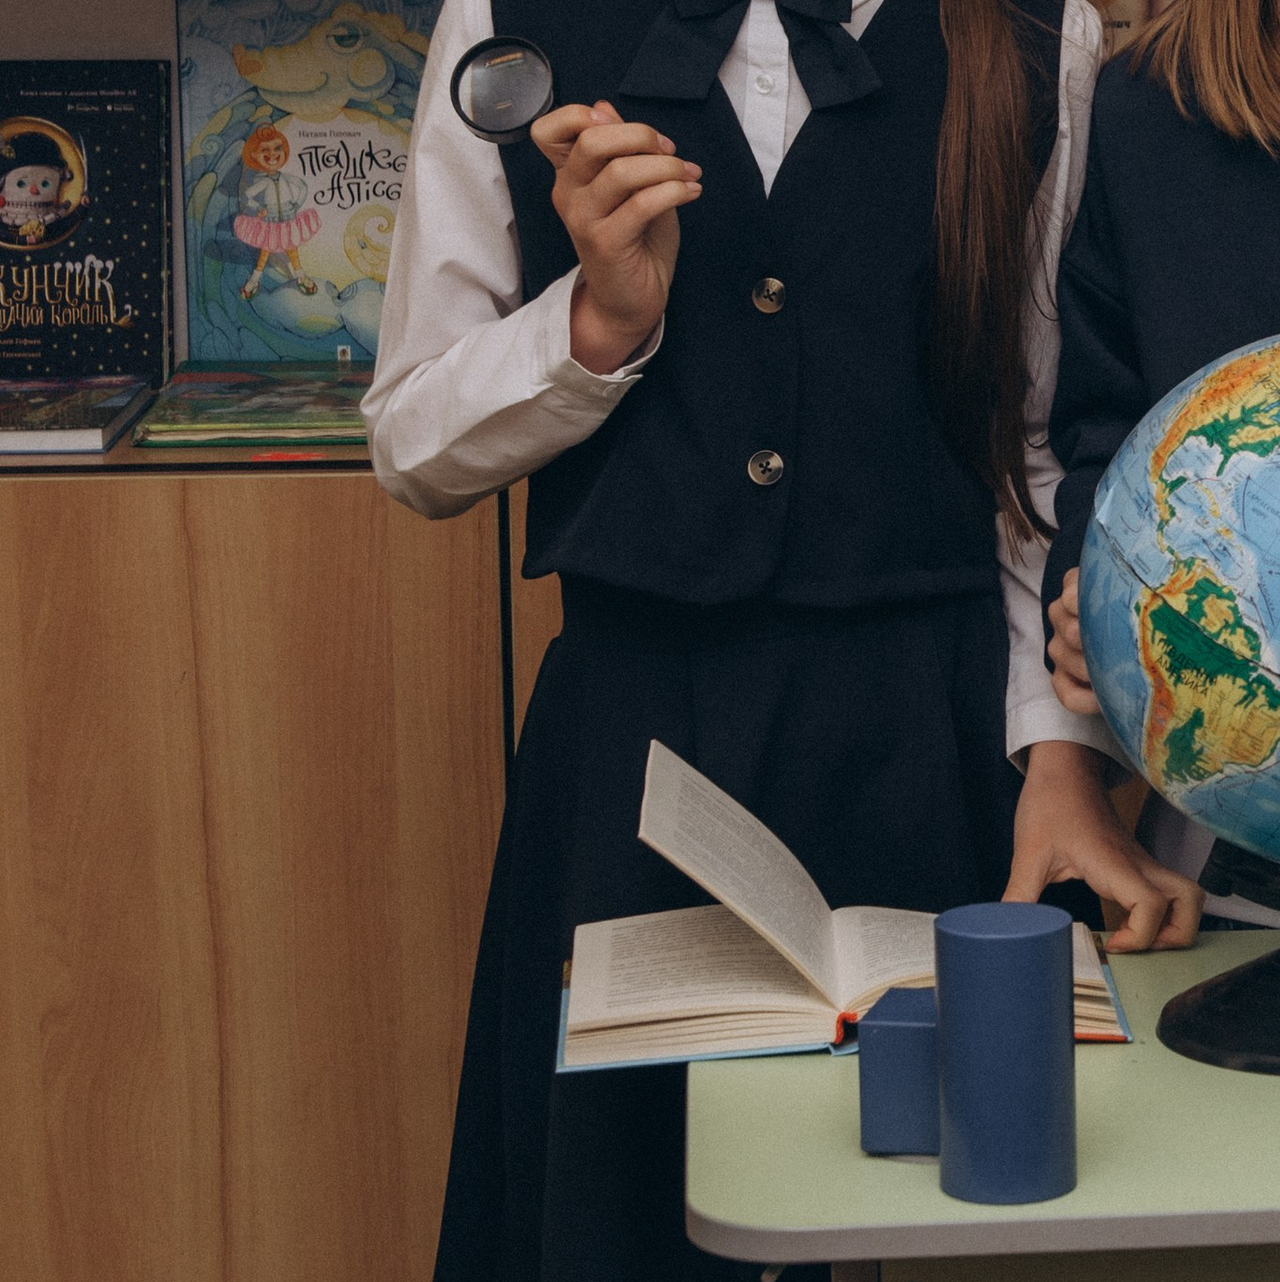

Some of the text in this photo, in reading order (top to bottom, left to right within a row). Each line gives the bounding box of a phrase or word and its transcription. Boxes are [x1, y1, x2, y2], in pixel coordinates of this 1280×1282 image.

[298, 129, 362, 138] Наталя Головач
[1156, 655, 1209, 698] АМЕРИКА
